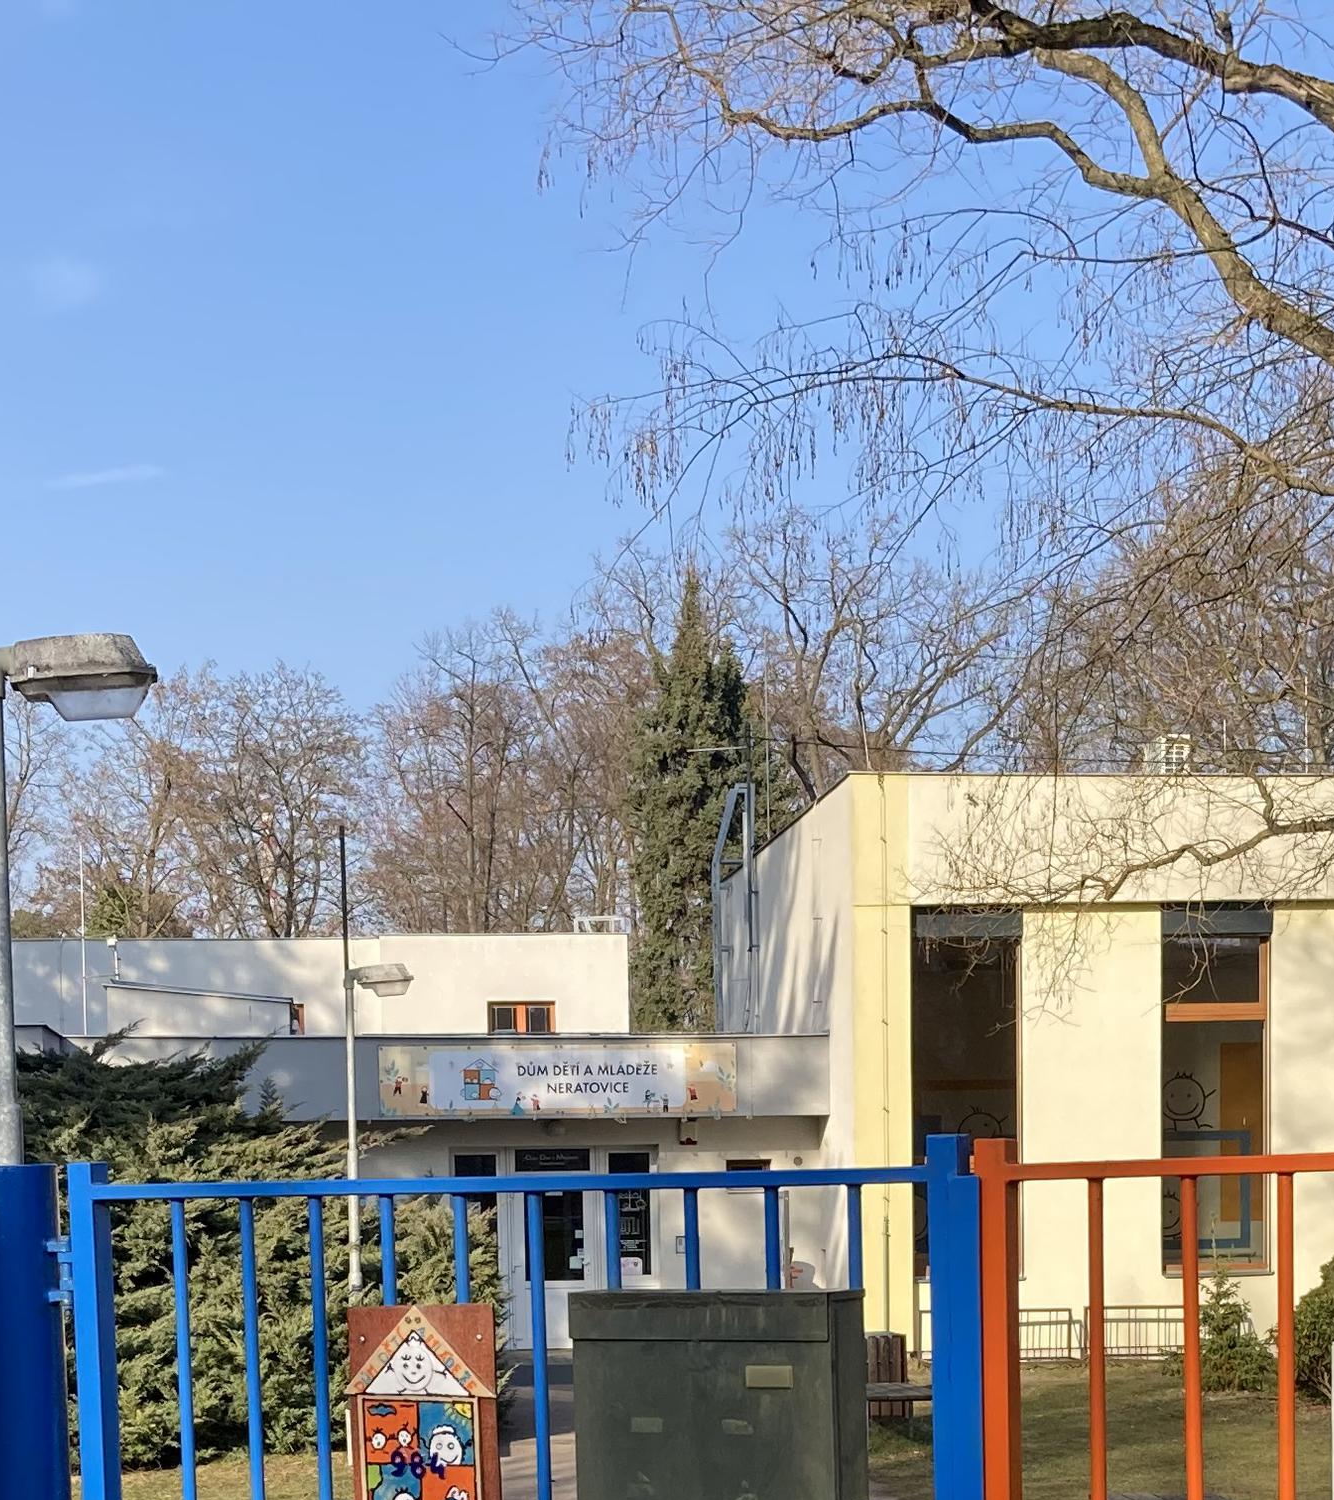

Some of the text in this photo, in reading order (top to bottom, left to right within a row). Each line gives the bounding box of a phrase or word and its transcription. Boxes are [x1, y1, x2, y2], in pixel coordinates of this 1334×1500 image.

[517, 1060, 657, 1076] DŮM DĚTÍ A MLÁDEŽE
[547, 1081, 629, 1093] NERATOVICE
[391, 1450, 446, 1480] 984
